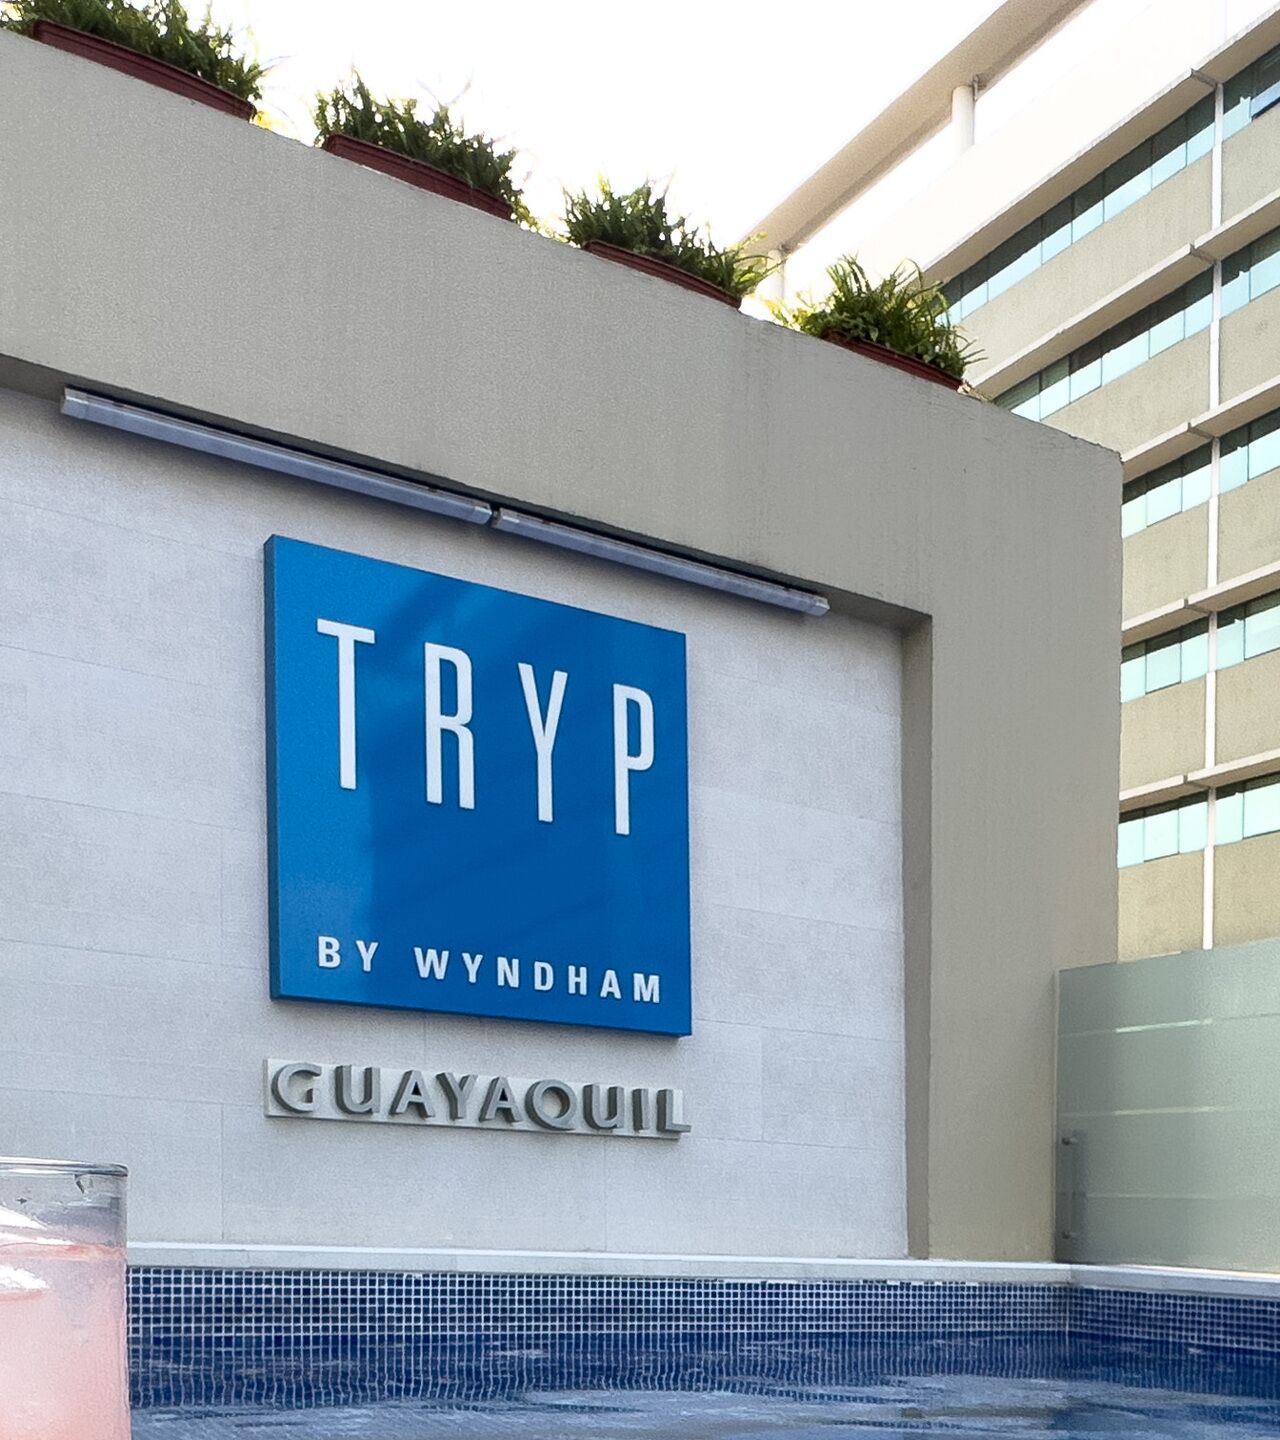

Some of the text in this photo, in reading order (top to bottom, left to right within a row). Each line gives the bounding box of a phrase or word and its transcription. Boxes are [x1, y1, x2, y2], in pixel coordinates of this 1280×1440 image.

[317, 618, 655, 836] TRYP
[317, 935, 661, 1004] BY WYNDHAM
[270, 1061, 692, 1134] GUAYAQUIL
